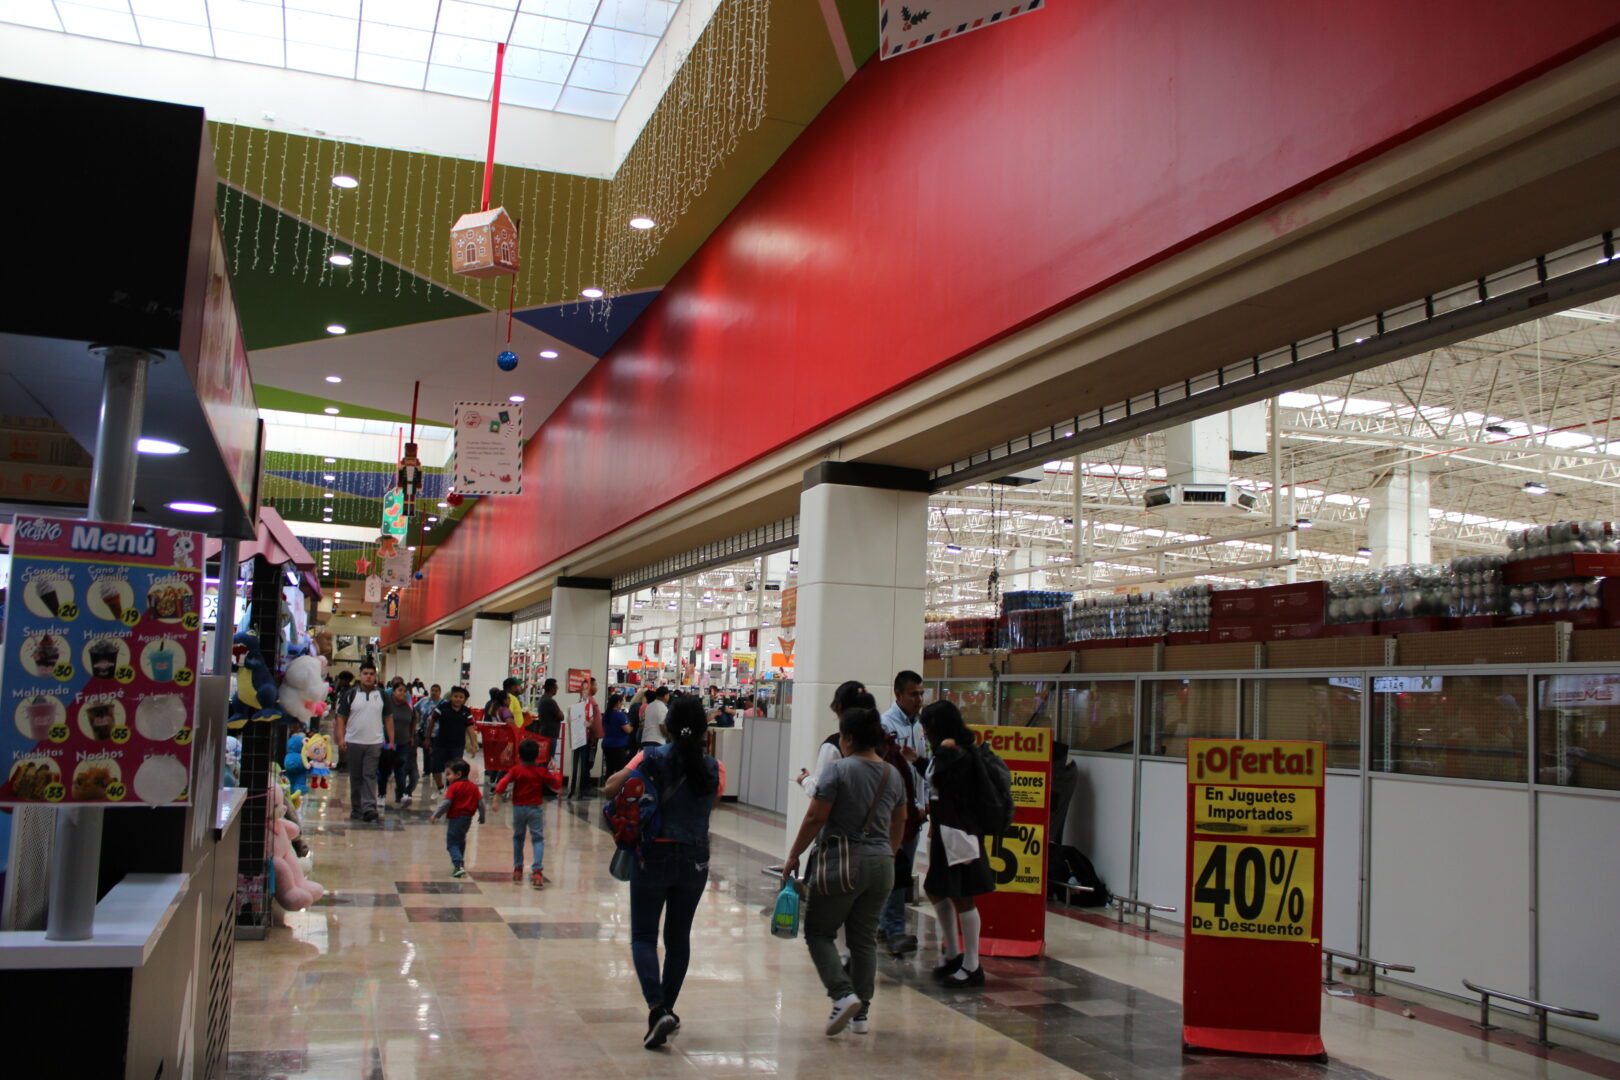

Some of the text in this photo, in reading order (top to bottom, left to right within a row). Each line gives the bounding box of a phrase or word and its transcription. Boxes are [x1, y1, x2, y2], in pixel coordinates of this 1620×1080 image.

[71, 525, 156, 556] Menú
[57, 566, 70, 574] de
[88, 566, 130, 574] Cono de
[146, 572, 194, 585] Tostitos
[23, 626, 70, 637] Sundae
[138, 632, 188, 643] Agua Nieve
[12, 686, 70, 698] Malteada
[75, 688, 125, 705] Frappé
[76, 750, 124, 762] Nachos
[1196, 746, 1315, 781] ¡Oferta!
[1010, 772, 1043, 788] icores
[1205, 787, 1297, 806] En Juguetes
[1207, 805, 1293, 822] Importados
[985, 826, 1041, 885] 5%
[1193, 844, 1304, 924] 40%
[1192, 916, 1304, 936] De Descuento
